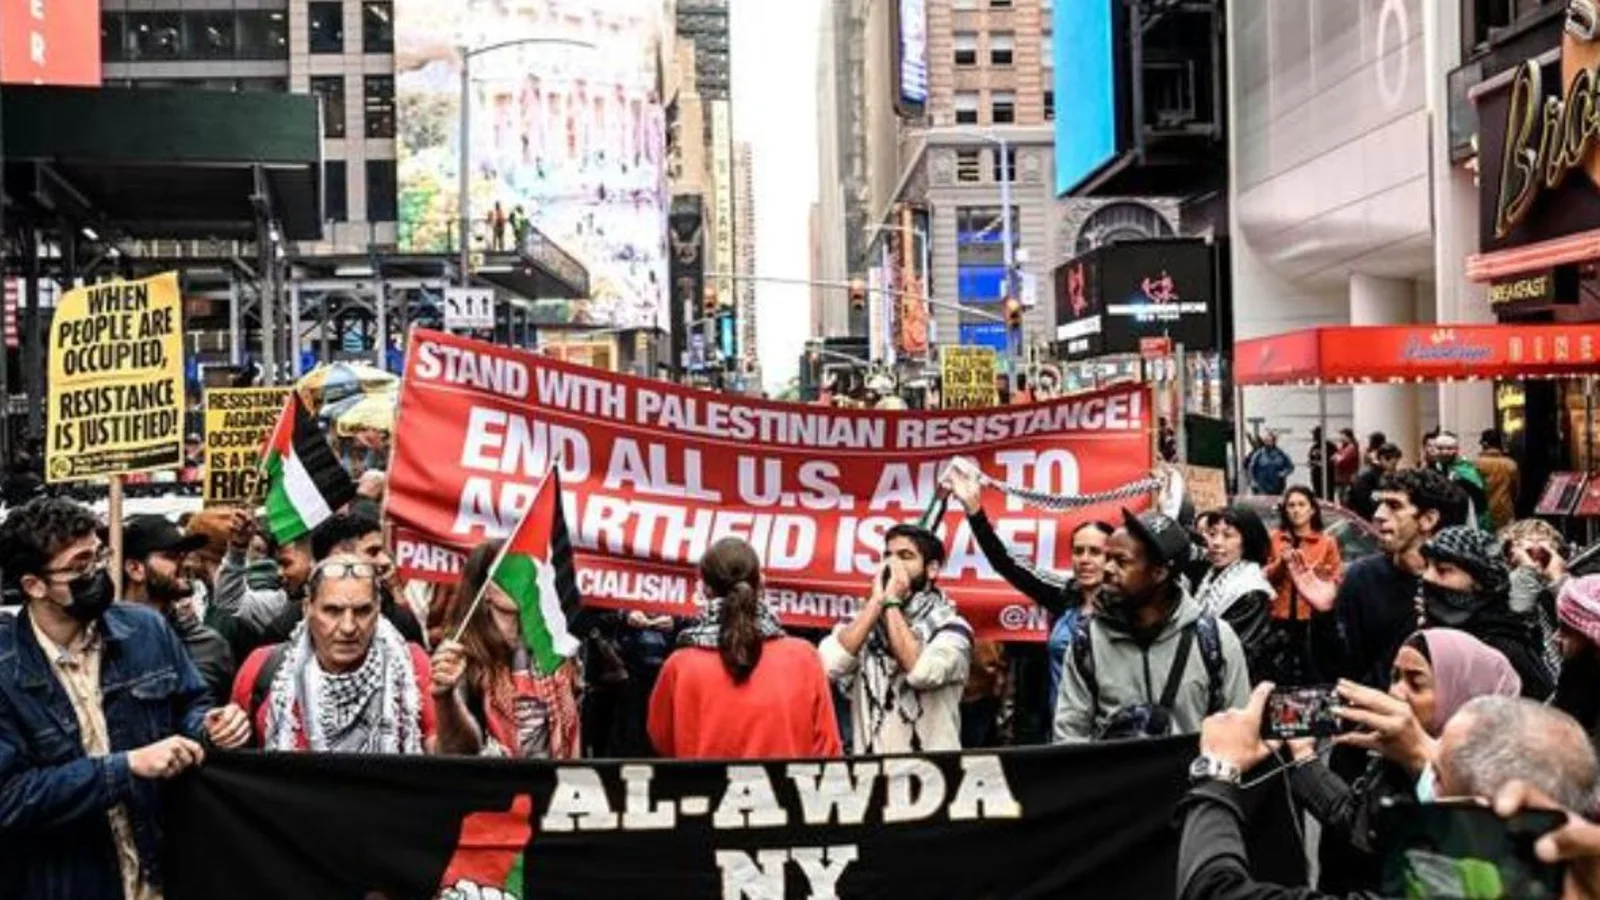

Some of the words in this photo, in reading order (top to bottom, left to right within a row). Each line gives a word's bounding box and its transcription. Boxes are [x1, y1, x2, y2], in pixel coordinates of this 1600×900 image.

[87, 283, 148, 315] WHEN
[58, 312, 132, 348] PEOPLE
[138, 306, 173, 340] ARE
[63, 339, 168, 375] OCCUPIED,
[59, 378, 175, 421] RESISTANCE
[208, 390, 289, 409] RESISTAN
[414, 341, 529, 398] STAND
[535, 366, 627, 420] WITH
[636, 388, 885, 449] PALESTINIAN
[896, 391, 1143, 449] RESISTANCE!
[54, 422, 75, 450] IS
[78, 408, 179, 452] JUSTIFIED!
[223, 409, 280, 428] AGAINS
[211, 452, 226, 468] IS
[229, 452, 240, 468] A
[461, 405, 592, 484] END
[602, 437, 722, 502] ALL
[737, 455, 855, 511] U.S.
[994, 449, 1080, 513] TO
[210, 468, 270, 499] RIGH
[834, 515, 1075, 581] ISAEL
[577, 567, 687, 605] CIALISM
[540, 755, 1021, 832] AL-AWDA
[715, 844, 858, 900] NY
